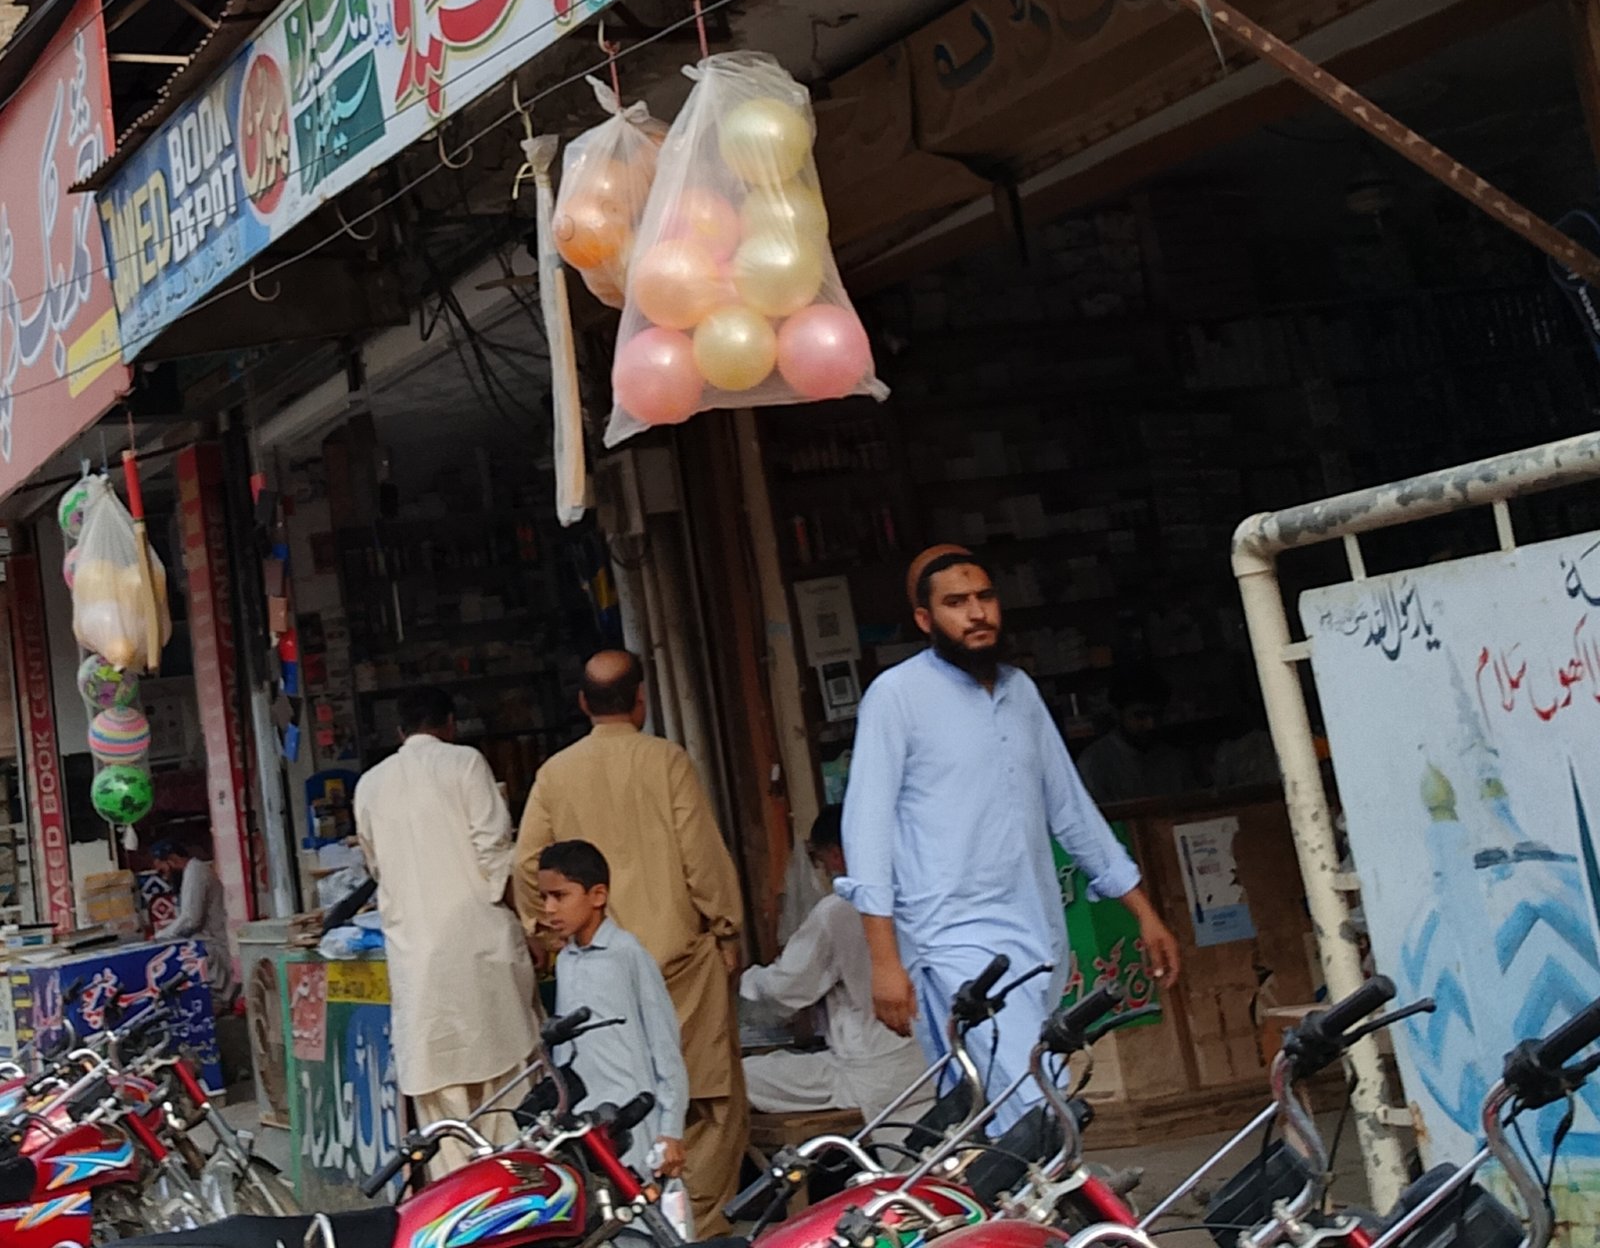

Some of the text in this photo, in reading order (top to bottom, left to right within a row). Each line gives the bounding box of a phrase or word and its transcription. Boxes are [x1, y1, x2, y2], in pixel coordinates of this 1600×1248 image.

[168, 80, 232, 199] BOOK
[170, 154, 237, 263] DEPOT
[34, 728, 58, 815] BOOK
[43, 825, 73, 936] SAEED
